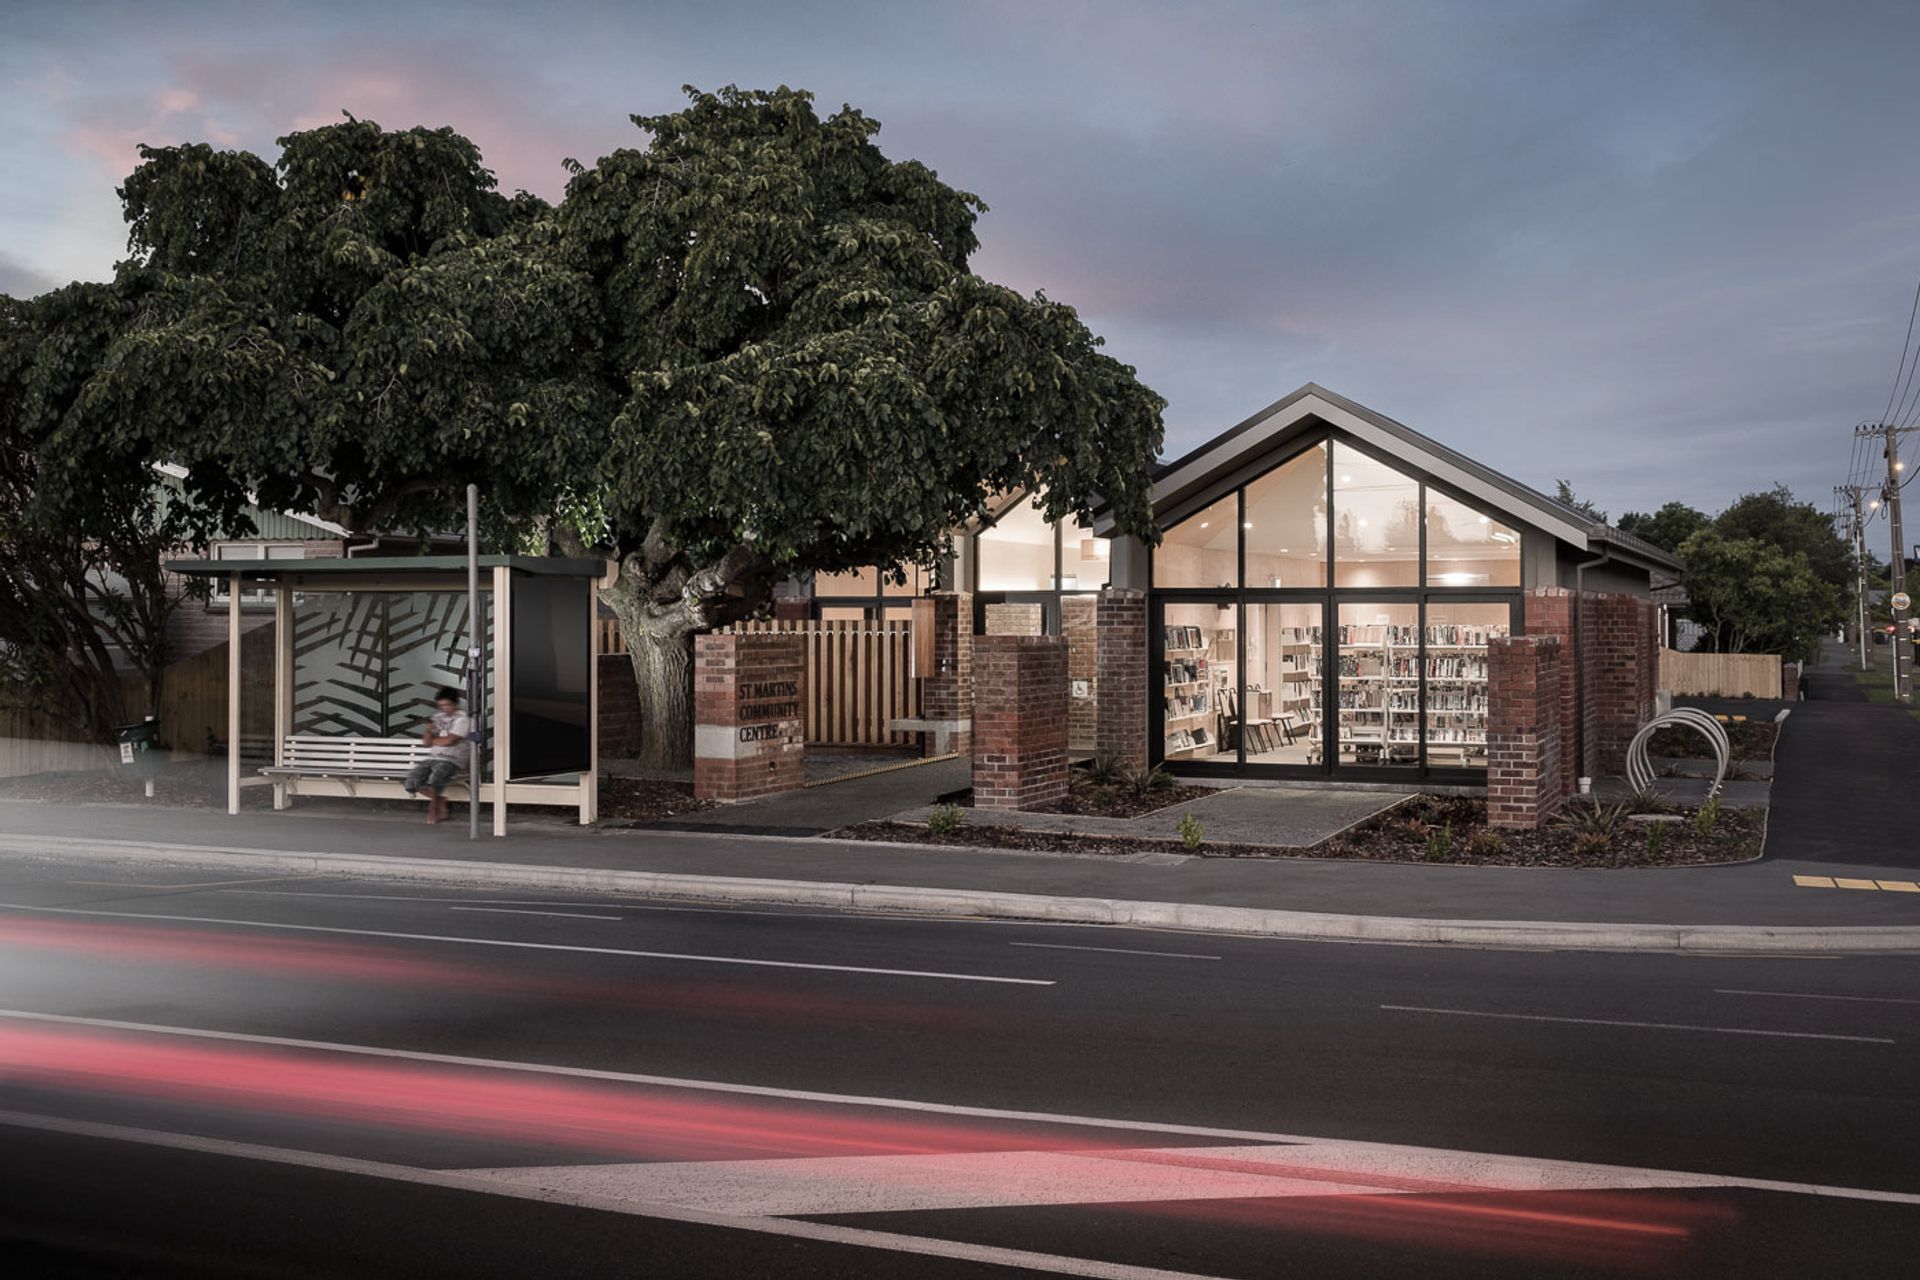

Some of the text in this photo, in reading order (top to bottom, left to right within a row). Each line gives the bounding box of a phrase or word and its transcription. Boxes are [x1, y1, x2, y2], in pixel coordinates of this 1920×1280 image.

[740, 681, 797, 699] ST MARTINS
[740, 702, 799, 720] COMMUNITY
[740, 724, 778, 742] CENTRE
